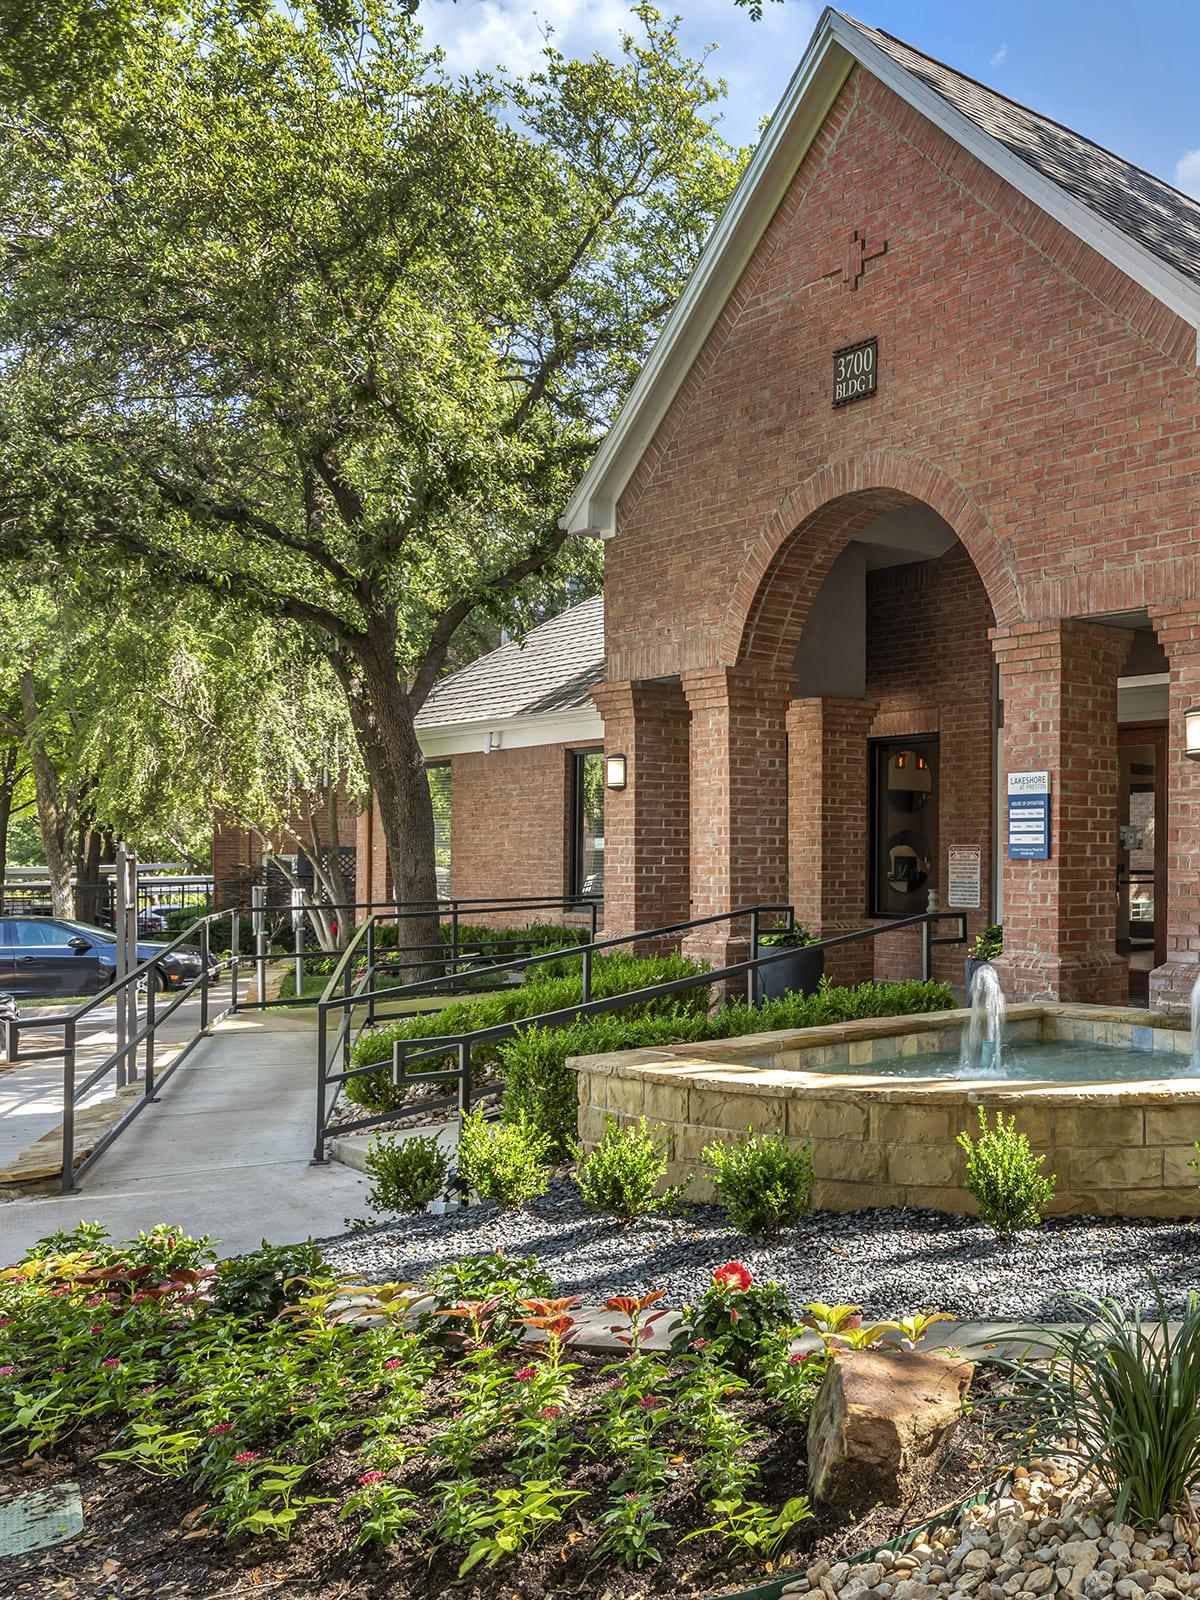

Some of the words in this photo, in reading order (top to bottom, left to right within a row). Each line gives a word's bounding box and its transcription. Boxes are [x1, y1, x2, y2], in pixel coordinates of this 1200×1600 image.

[837, 348, 872, 381] 3700
[836, 376, 865, 399] BLDG
[868, 374, 873, 389] 1
[1010, 775, 1047, 785] LAKESHORE
